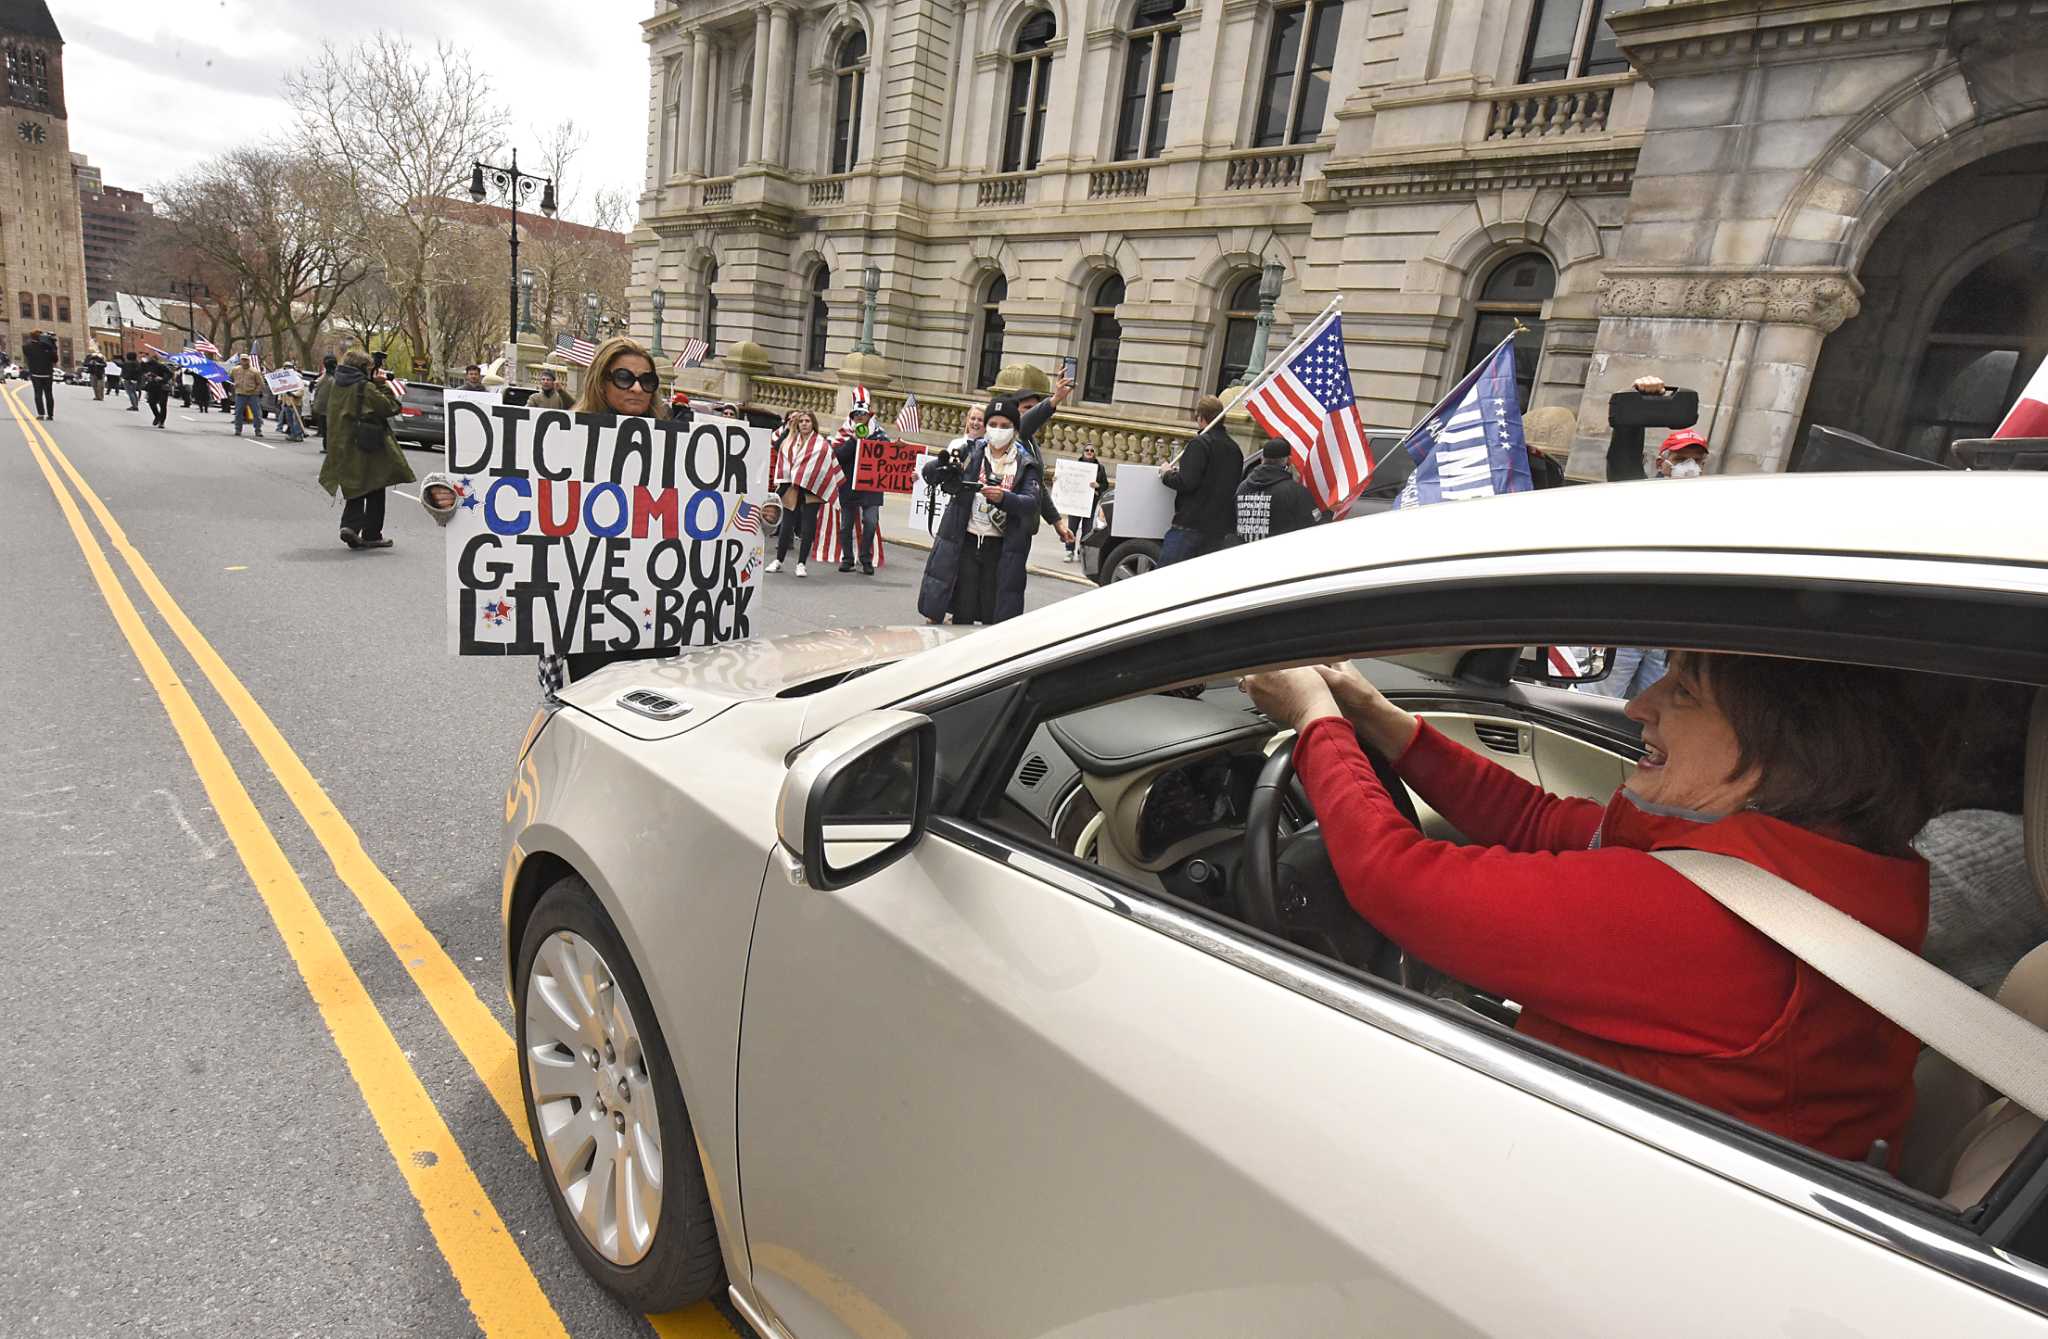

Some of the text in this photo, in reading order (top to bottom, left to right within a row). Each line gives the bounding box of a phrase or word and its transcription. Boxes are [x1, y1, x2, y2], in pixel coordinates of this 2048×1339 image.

[448, 401, 750, 494] DICTATOR
[862, 443, 884, 459] NO
[484, 476, 725, 541] CUOMO
[1237, 525, 1269, 534] MERICAN
[458, 533, 744, 591] GIVE OUR
[459, 587, 755, 656] LIVES BACK
